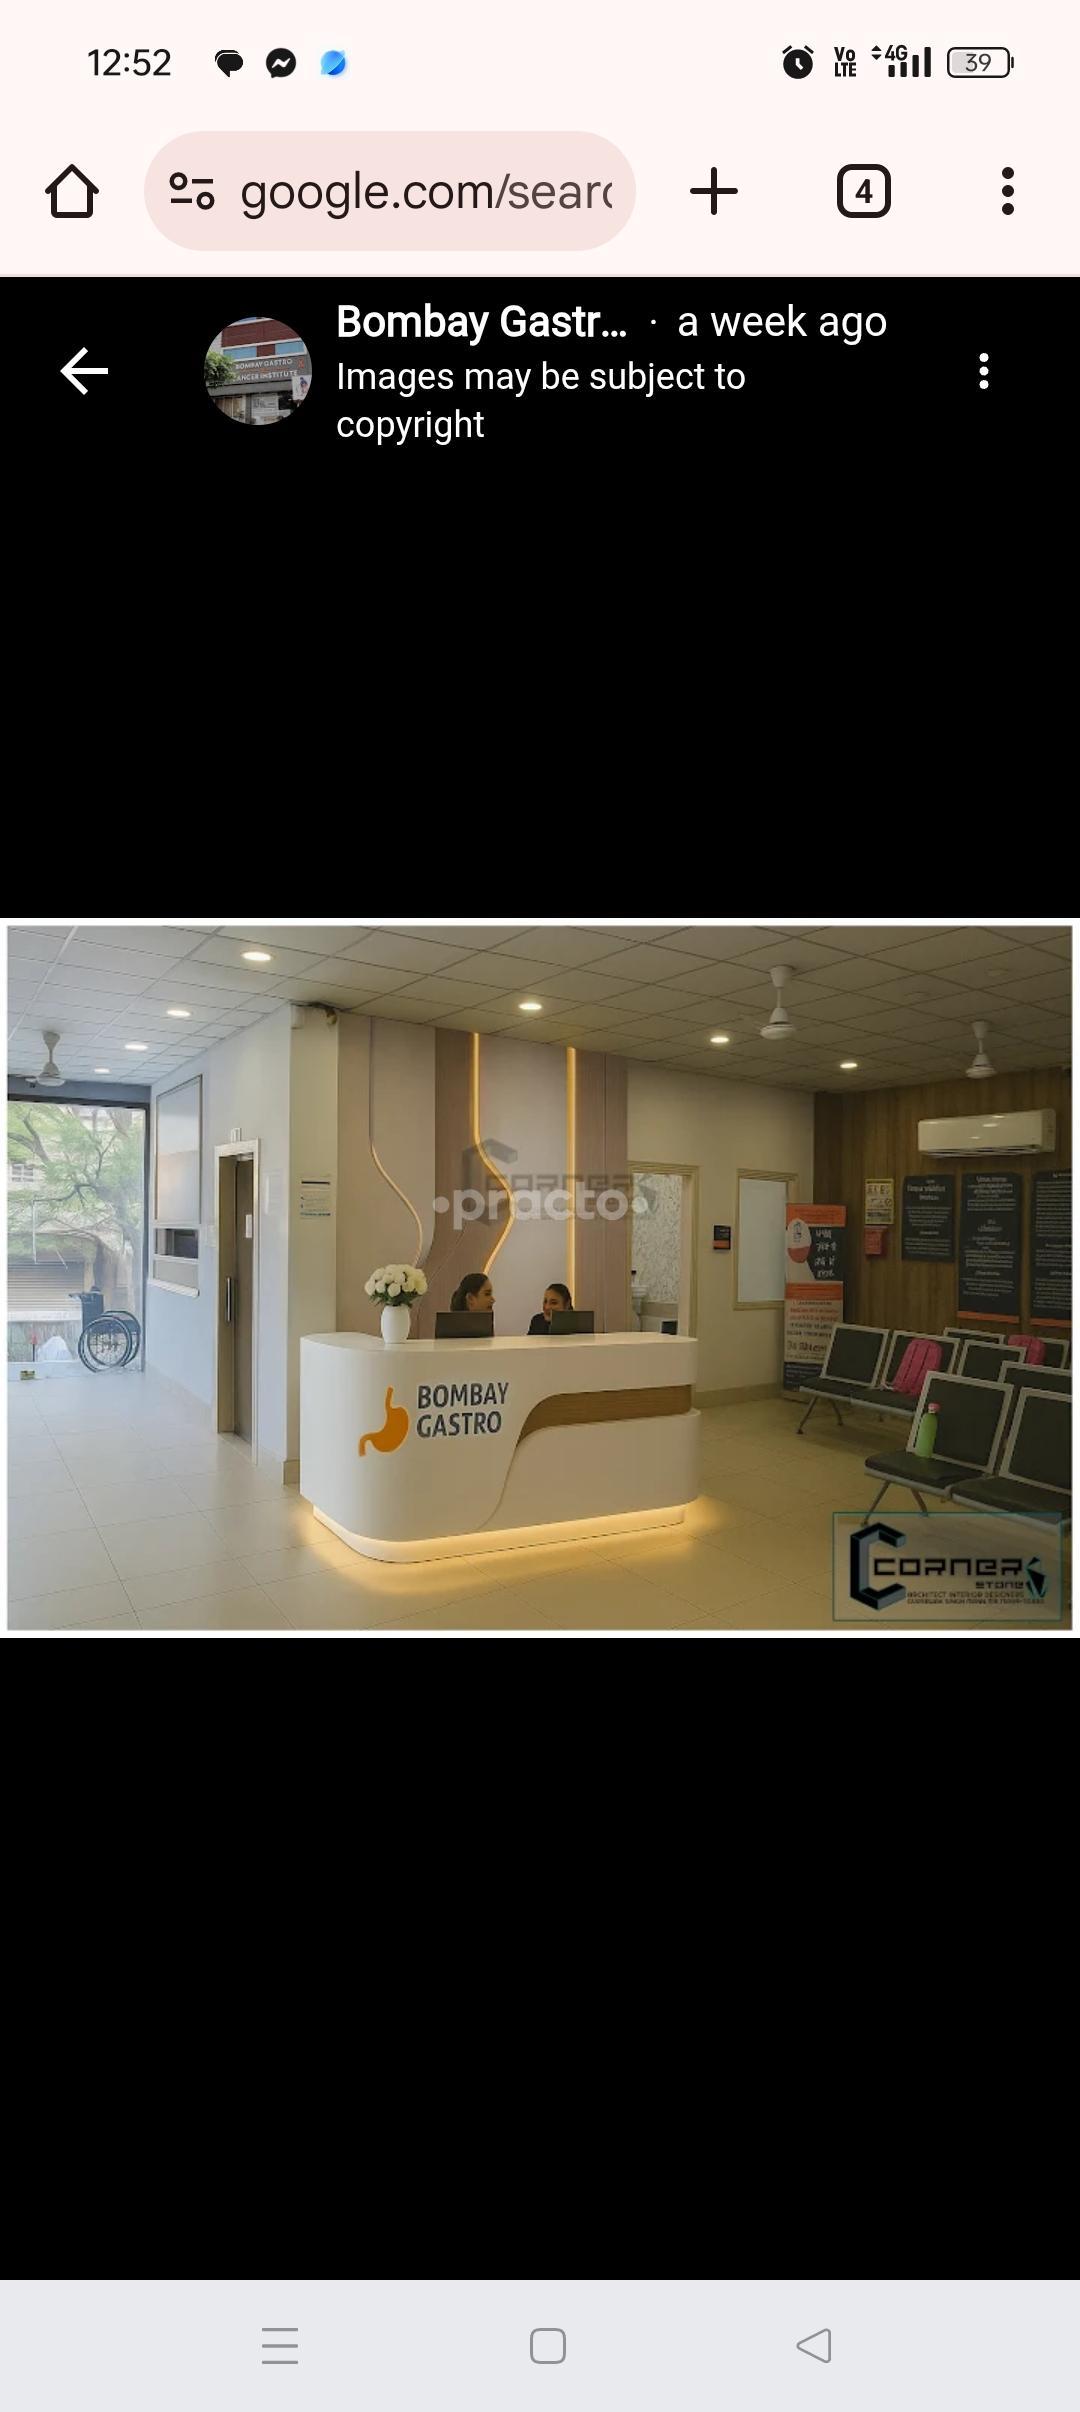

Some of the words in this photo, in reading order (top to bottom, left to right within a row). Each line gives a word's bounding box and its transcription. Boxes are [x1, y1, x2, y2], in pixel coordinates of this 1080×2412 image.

[89, 48, 171, 77] 12:52
[834, 46, 856, 61] Vo
[885, 44, 908, 61] 4G
[965, 53, 992, 72] 39
[834, 62, 857, 77] LTE
[855, 178, 873, 204] 4
[337, 304, 490, 347] Bombay
[678, 312, 698, 337] a
[711, 303, 808, 337] week
[819, 312, 888, 346] ago
[338, 362, 454, 398] Images
[465, 368, 532, 398] may
[542, 360, 580, 390] be
[589, 360, 705, 398] subject
[714, 363, 746, 390] to
[336, 408, 485, 446] copyright
[417, 1382, 510, 1409] BOMBAY
[416, 1410, 503, 1438] GASTRO
